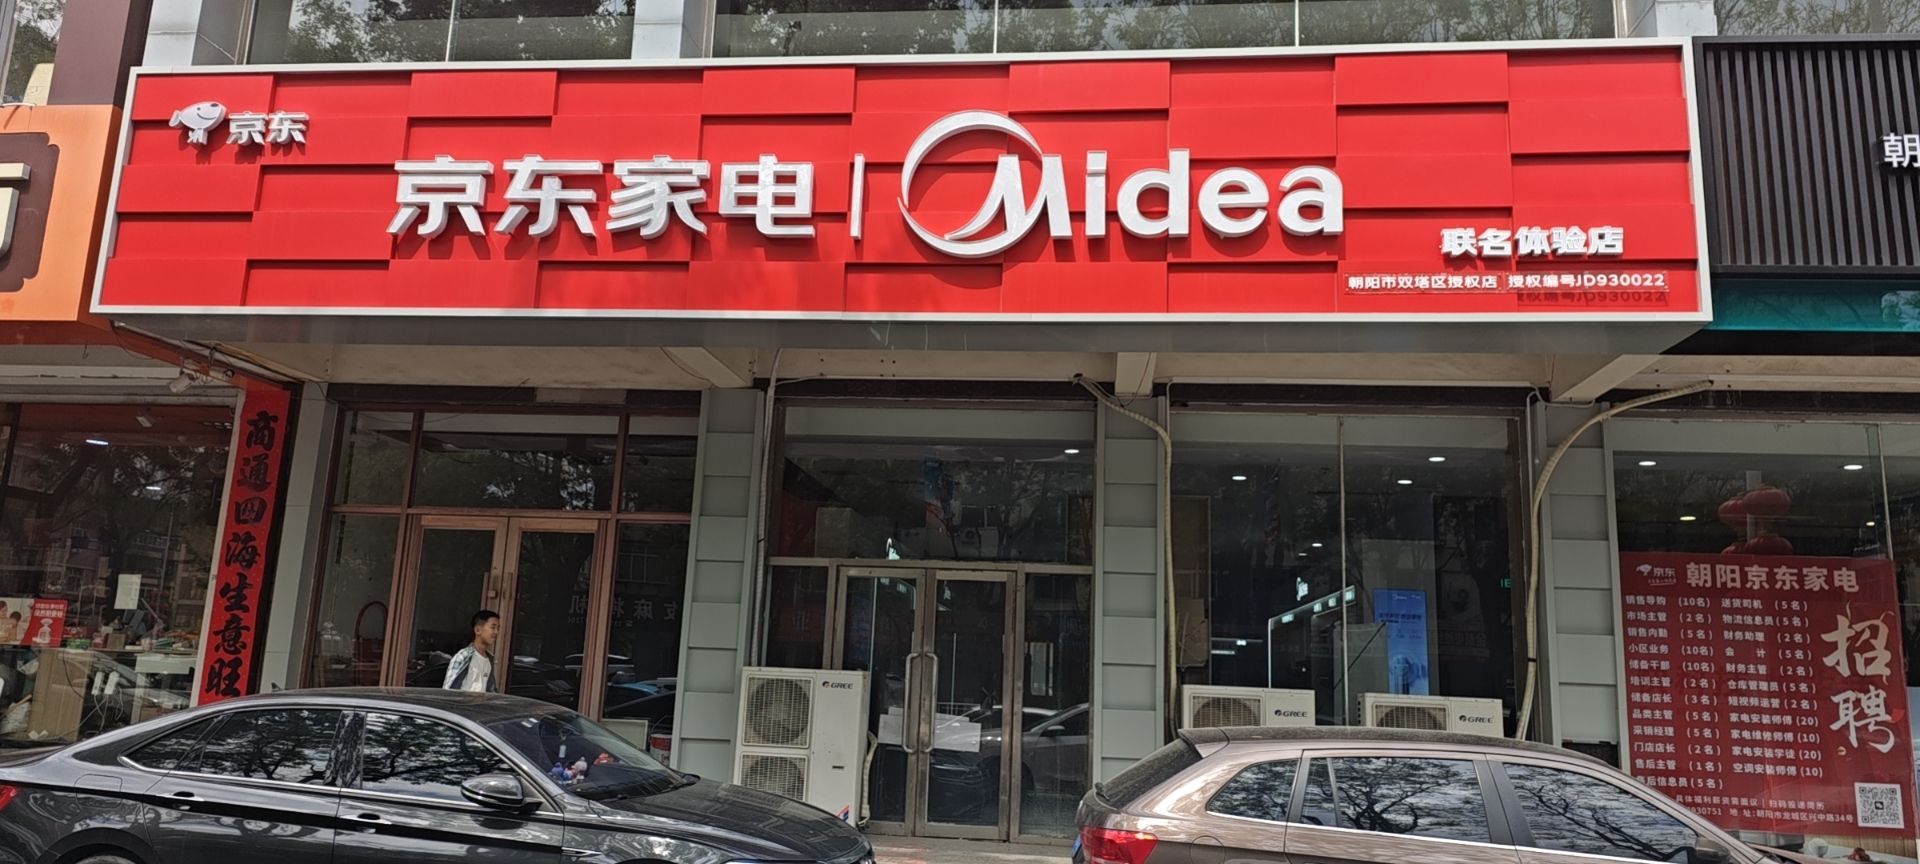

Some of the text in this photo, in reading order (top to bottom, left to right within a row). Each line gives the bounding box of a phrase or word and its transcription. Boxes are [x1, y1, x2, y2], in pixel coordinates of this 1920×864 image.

[227, 111, 309, 145] 京东
[1882, 132, 1920, 168] 朝
[386, 109, 1344, 258] 京东家电 Midea
[1441, 226, 1624, 258] 联名体验店
[1348, 273, 1665, 290] 朝阳市双塔区授权店 授权编号JD930022
[204, 410, 280, 698] 商通四海生意旺
[1686, 562, 1859, 593] 朝阳京东家电
[1626, 595, 1666, 605] 销售导购
[1721, 598, 1763, 609] 送货司机
[1626, 612, 1667, 621] 市场主管
[1723, 615, 1774, 626] 物流信息员
[1627, 628, 1668, 638] 销售内勤
[1724, 631, 1765, 642] 财务助理
[1628, 644, 1669, 654] 小区业务
[1629, 659, 1670, 670] 储备干部
[1726, 663, 1767, 674] 财务主管
[1630, 676, 1671, 687] 培训主管
[1821, 604, 1895, 753] 招聘
[831, 680, 853, 690] GREE
[1727, 680, 1779, 692] 仓库管理员
[1631, 693, 1672, 703] 储备店长
[1728, 696, 1780, 709] 短视频运营
[1283, 710, 1307, 718] GREE
[1469, 714, 1493, 724] GREE
[1632, 709, 1673, 720] 品类主管
[1729, 713, 1818, 727] 家电安装师傅 (20)
[1731, 729, 1820, 744] 家电维修师傅 (10)
[1634, 743, 1675, 753] 门店店长
[1732, 746, 1821, 761] 家电安装学徒 (20)
[1635, 759, 1676, 770] 售后主管
[1733, 763, 1823, 778] 空调安装师傅 (10)
